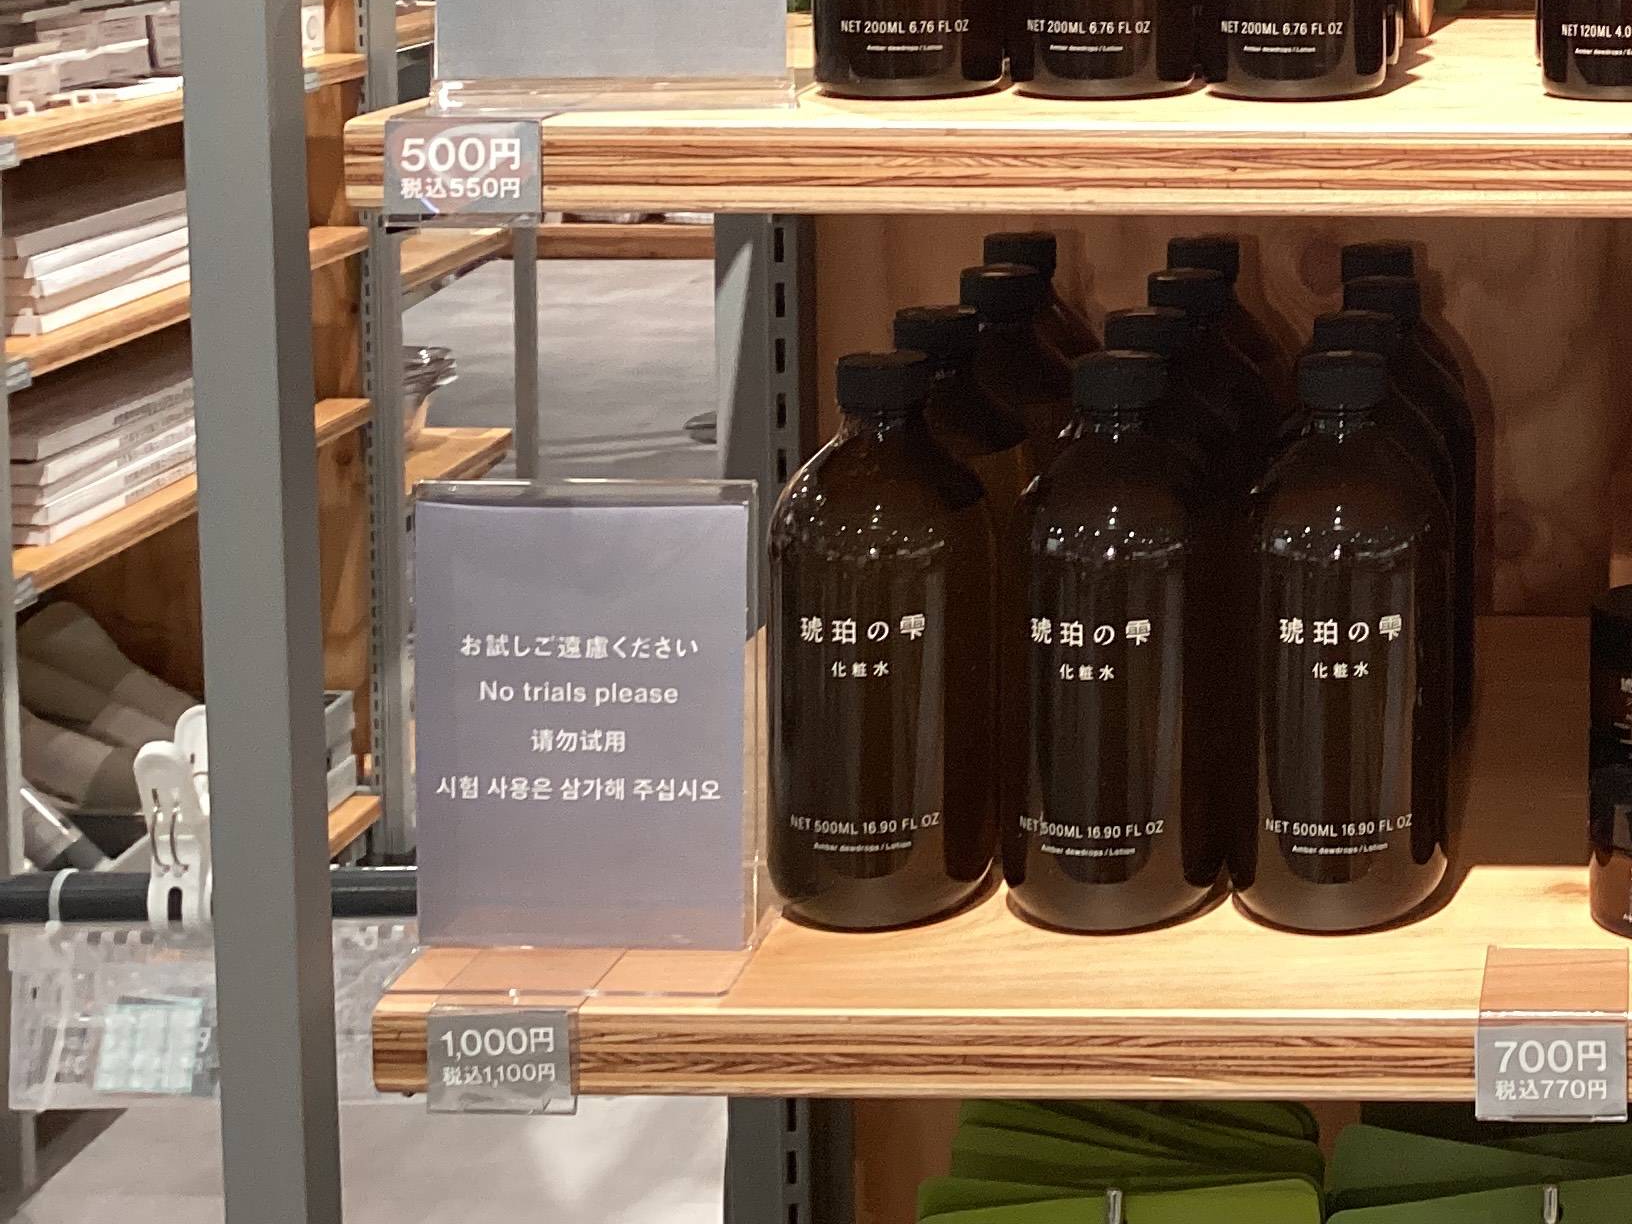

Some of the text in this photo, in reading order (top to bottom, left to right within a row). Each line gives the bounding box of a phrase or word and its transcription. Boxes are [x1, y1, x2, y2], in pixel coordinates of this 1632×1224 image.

[841, 19, 862, 33] NET
[864, 20, 906, 34] 200ML
[938, 20, 952, 32] FL
[955, 19, 968, 32] OZ
[1027, 19, 1045, 33] NET
[1047, 21, 1086, 35] 200ML
[1118, 22, 1131, 34] FL
[1135, 21, 1150, 33] OZ
[1222, 21, 1239, 33] NET
[1241, 22, 1279, 35] 200ML
[1311, 23, 1325, 35] FL
[1328, 22, 1343, 34] OZ
[1562, 24, 1578, 36] NET
[1581, 25, 1612, 38] 120ML
[401, 138, 520, 173] 500円
[400, 176, 520, 200] 税込550円
[801, 614, 925, 644] 琥珀の雫
[1031, 618, 1150, 647] 琥珀の雫
[1280, 615, 1401, 645] 琥珀の雫
[461, 634, 698, 659] お試しご遠慮ください
[832, 661, 889, 677] 化粧水
[1060, 664, 1114, 680] 化粧水
[1312, 661, 1368, 678] 化粧水
[480, 681, 678, 706] No trials please
[531, 729, 625, 752] 请勿试用
[436, 776, 720, 801] 시험 사용은 삼가해 주십시오
[791, 815, 811, 829] NET
[815, 820, 858, 835] 500ML
[902, 818, 918, 830] FL
[921, 812, 939, 827] OZ
[1019, 815, 1039, 832] NET
[1040, 823, 1083, 839] 500ML
[1126, 824, 1141, 836] FL
[1146, 820, 1163, 834] OZ
[1265, 817, 1289, 833] NET
[1292, 821, 1338, 837] 500ML
[1379, 820, 1393, 832] FL
[1397, 814, 1412, 828] OZ
[440, 1027, 554, 1061] 1,000円
[1494, 1040, 1606, 1073] 700円
[443, 1064, 555, 1088] 税込1,100円
[1496, 1079, 1606, 1100] 税込770円
